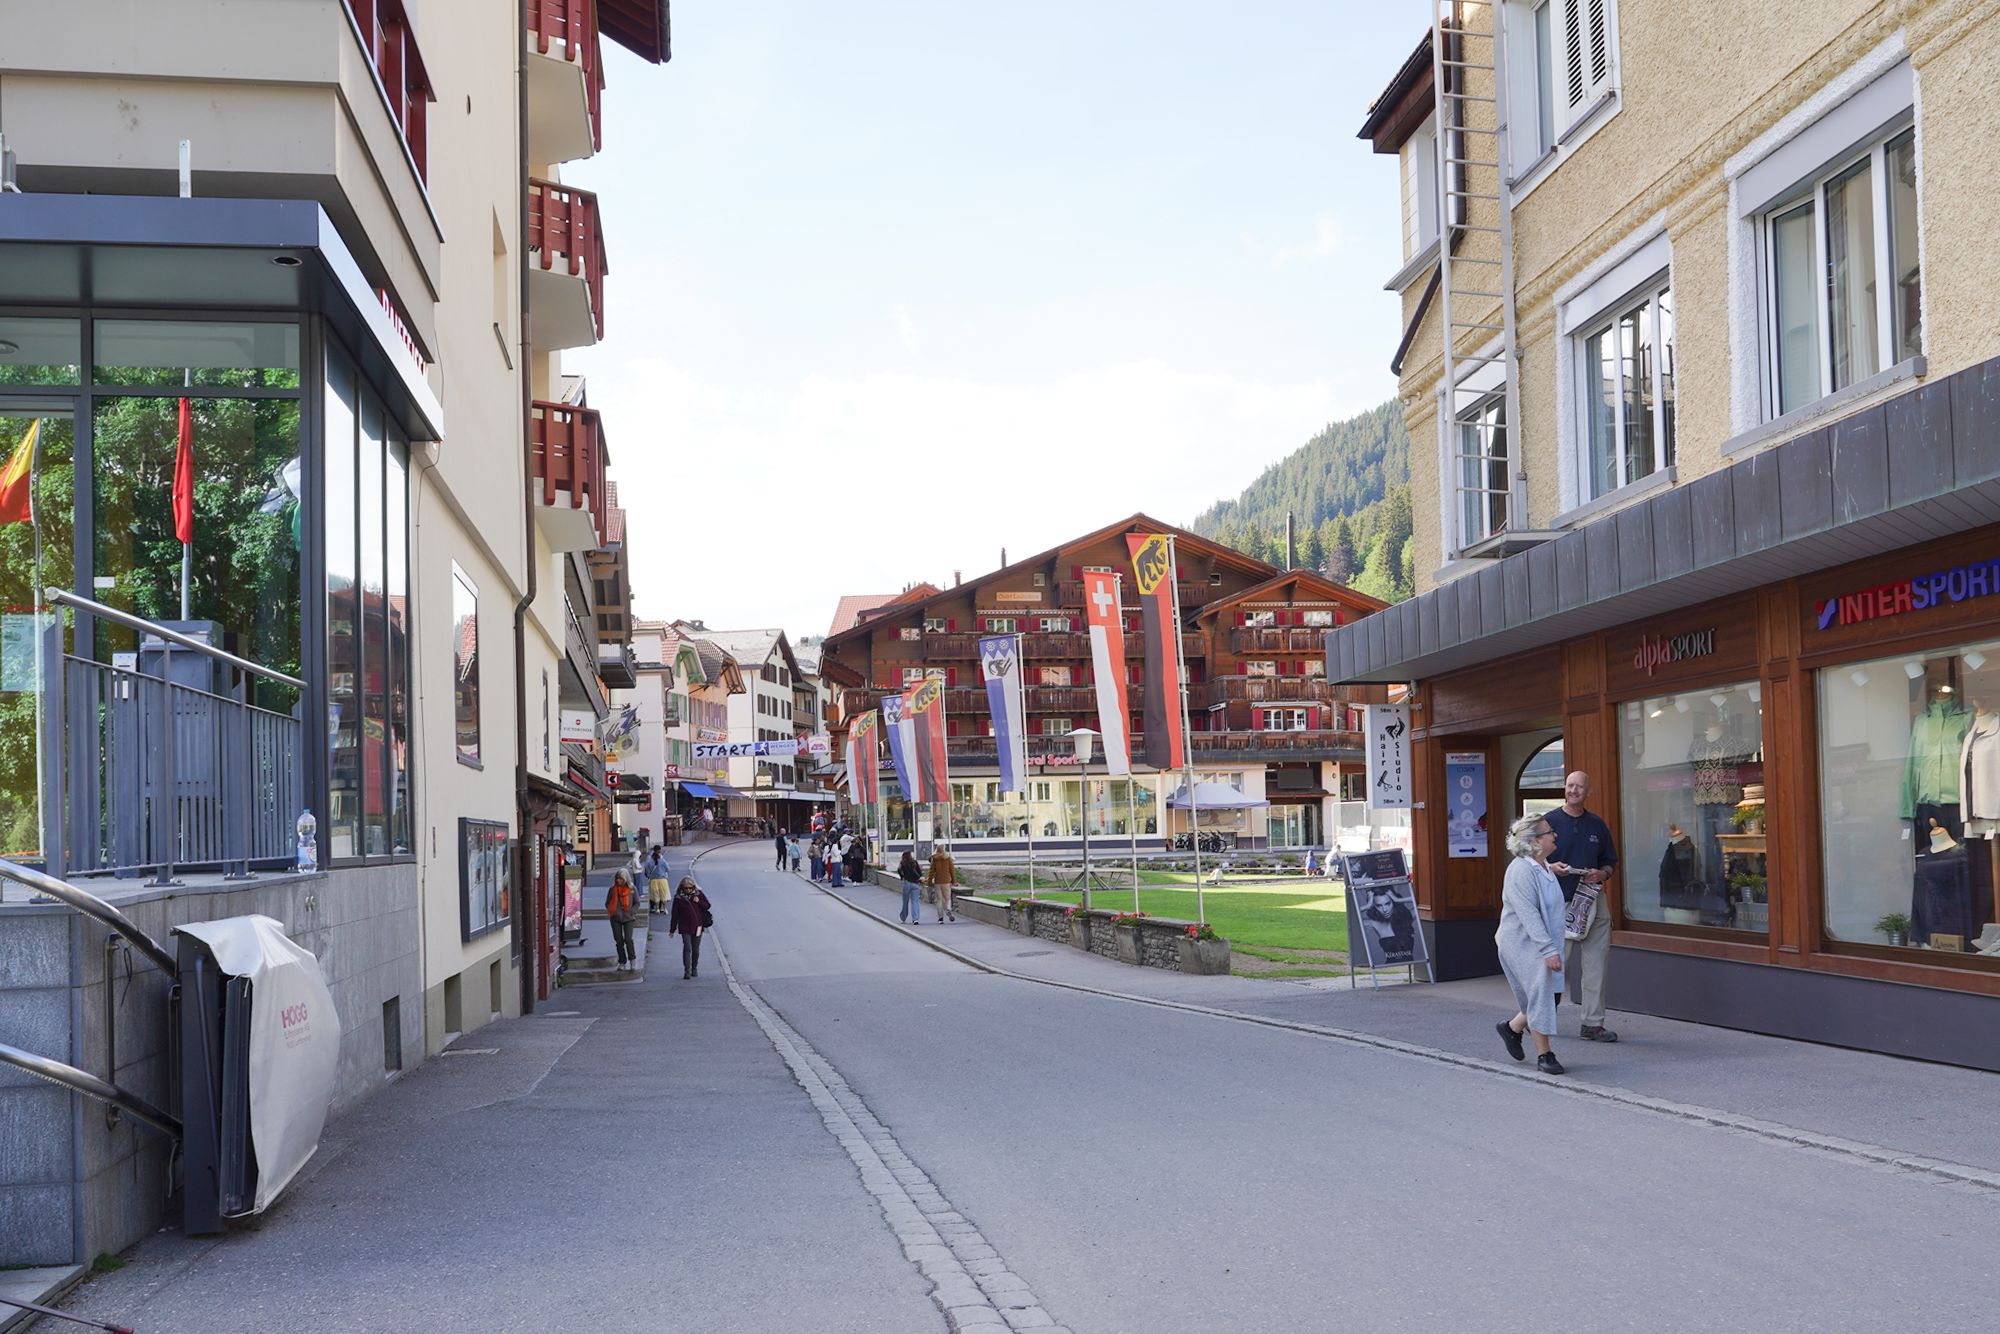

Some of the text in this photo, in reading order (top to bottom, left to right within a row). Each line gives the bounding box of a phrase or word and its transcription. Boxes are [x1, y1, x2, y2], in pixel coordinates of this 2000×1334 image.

[1838, 556, 2000, 626] INTERSPORT
[696, 744, 752, 757] START
[1047, 754, 1078, 767] Sport
